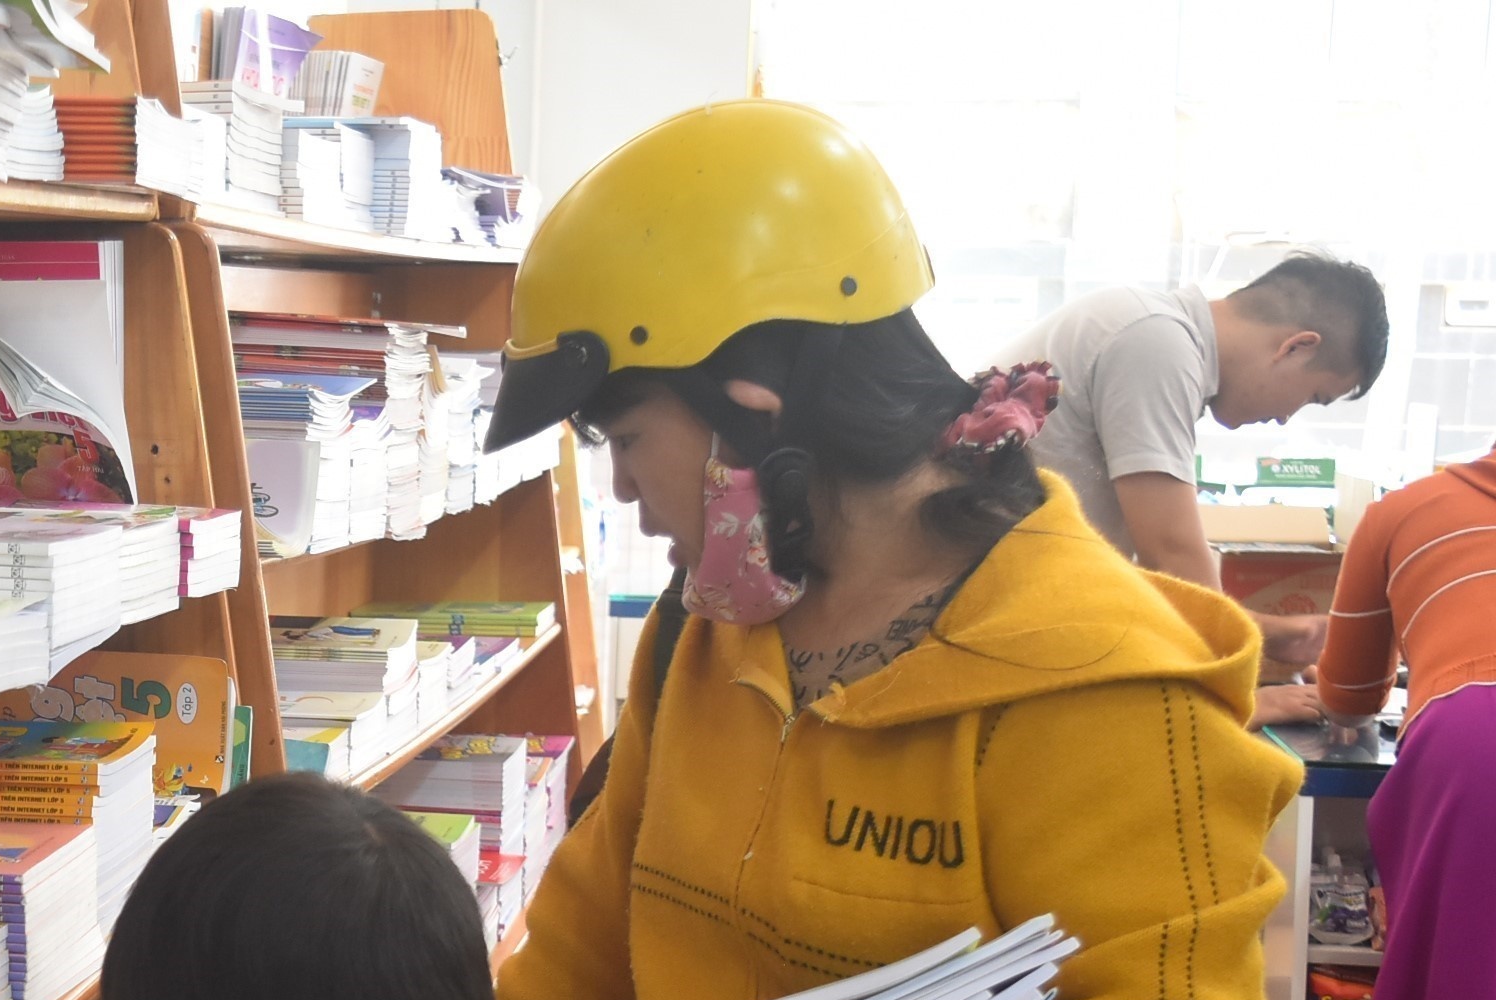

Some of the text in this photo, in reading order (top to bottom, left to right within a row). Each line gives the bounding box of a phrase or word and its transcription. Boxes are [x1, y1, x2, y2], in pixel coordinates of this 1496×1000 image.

[72, 429, 101, 466] 5
[1282, 463, 1322, 476] XYLITOL
[120, 676, 173, 720] 5
[181, 686, 194, 717] Tập 2
[824, 799, 965, 869] UNIOU
